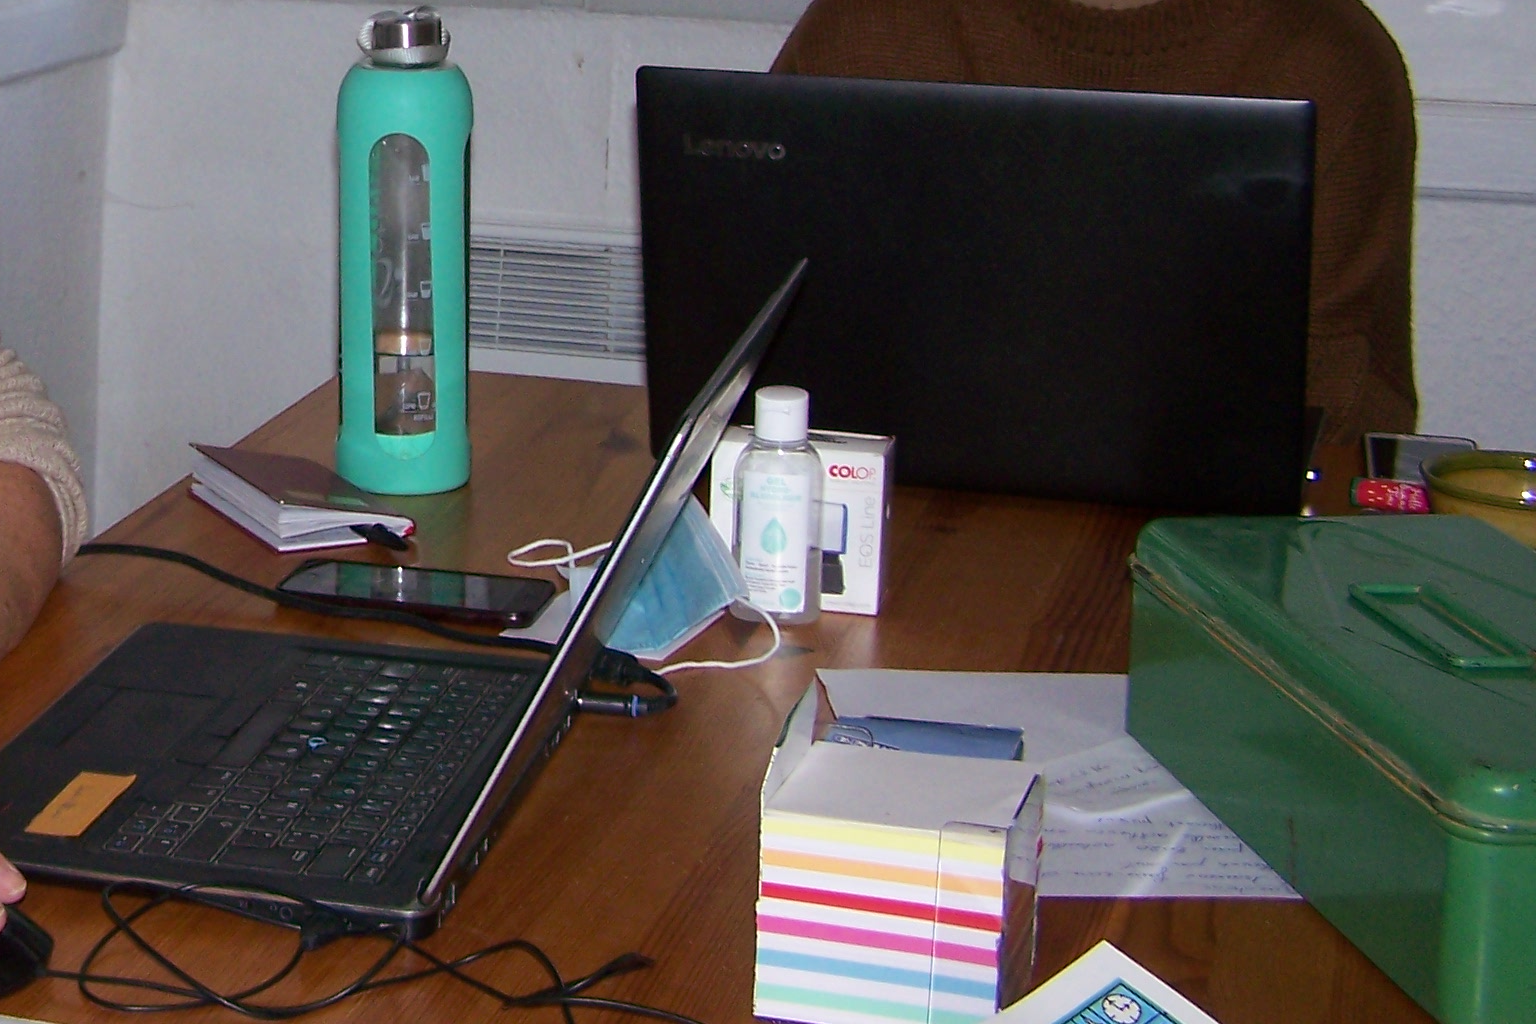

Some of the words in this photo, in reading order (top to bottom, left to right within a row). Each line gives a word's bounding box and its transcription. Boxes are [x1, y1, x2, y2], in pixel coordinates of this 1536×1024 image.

[683, 134, 786, 161] Lenovo
[863, 495, 877, 529] Line
[858, 529, 875, 569] EOS
